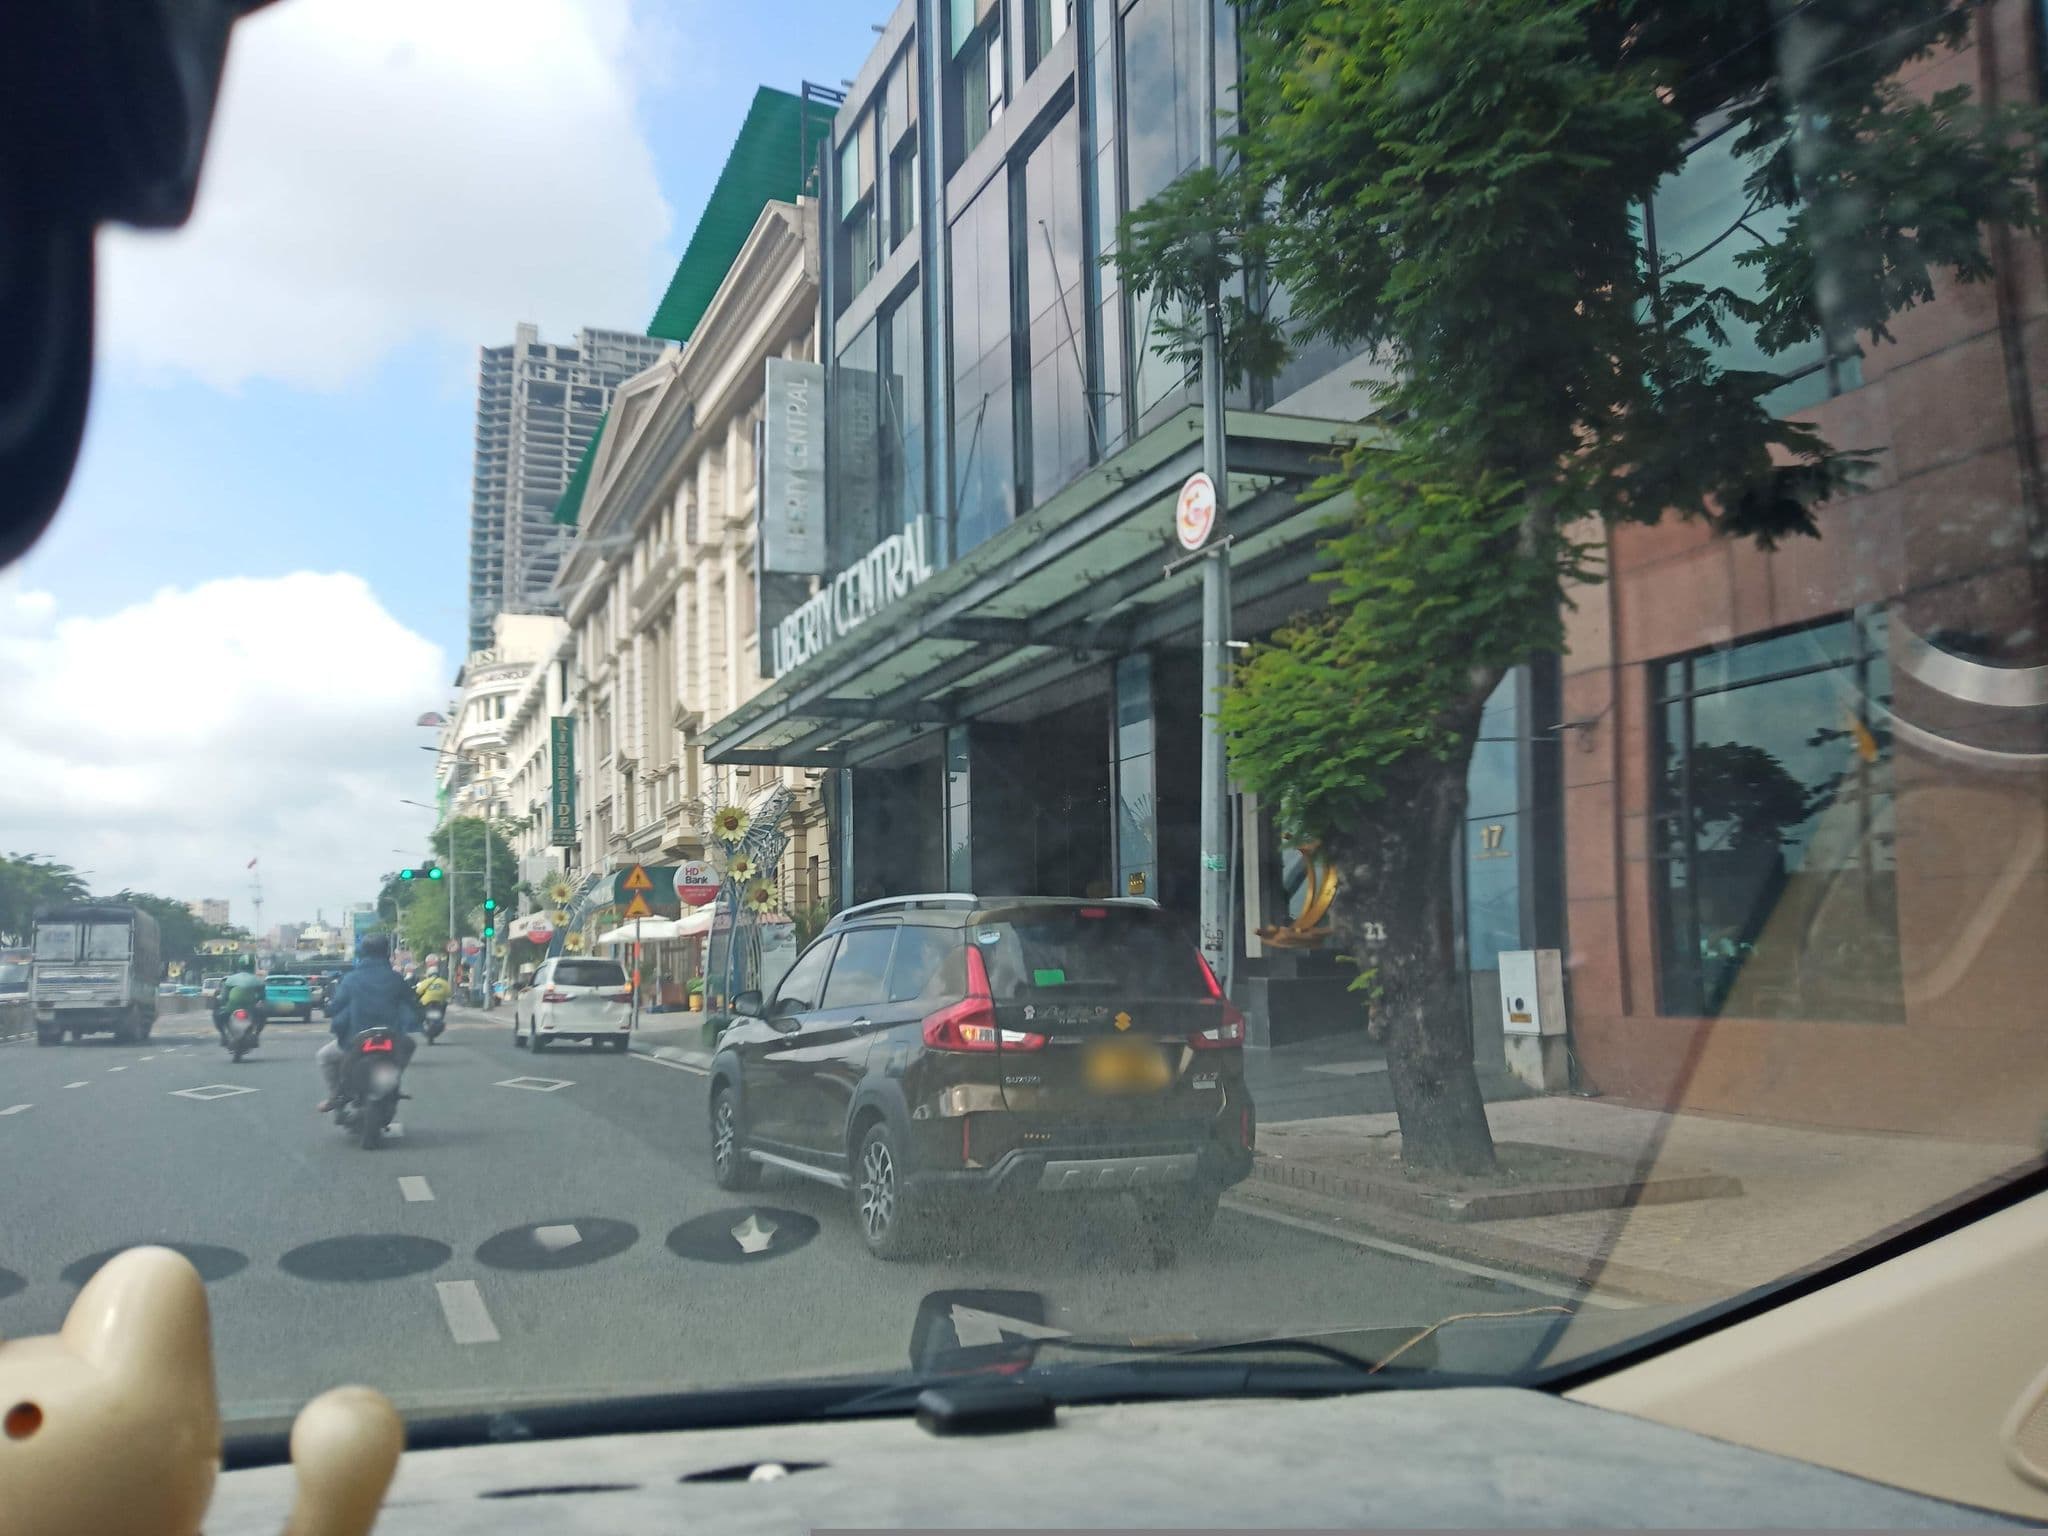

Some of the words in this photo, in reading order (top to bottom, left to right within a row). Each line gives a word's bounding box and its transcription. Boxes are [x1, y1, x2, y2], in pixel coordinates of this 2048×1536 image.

[786, 377, 809, 472] CENTRAL
[772, 582, 834, 679] LIBERTY
[834, 513, 934, 637] CENTRAL
[557, 718, 570, 828] RIVERSIDE
[1480, 825, 1504, 848] 17
[685, 867, 699, 876] HD
[685, 876, 709, 885] Bank
